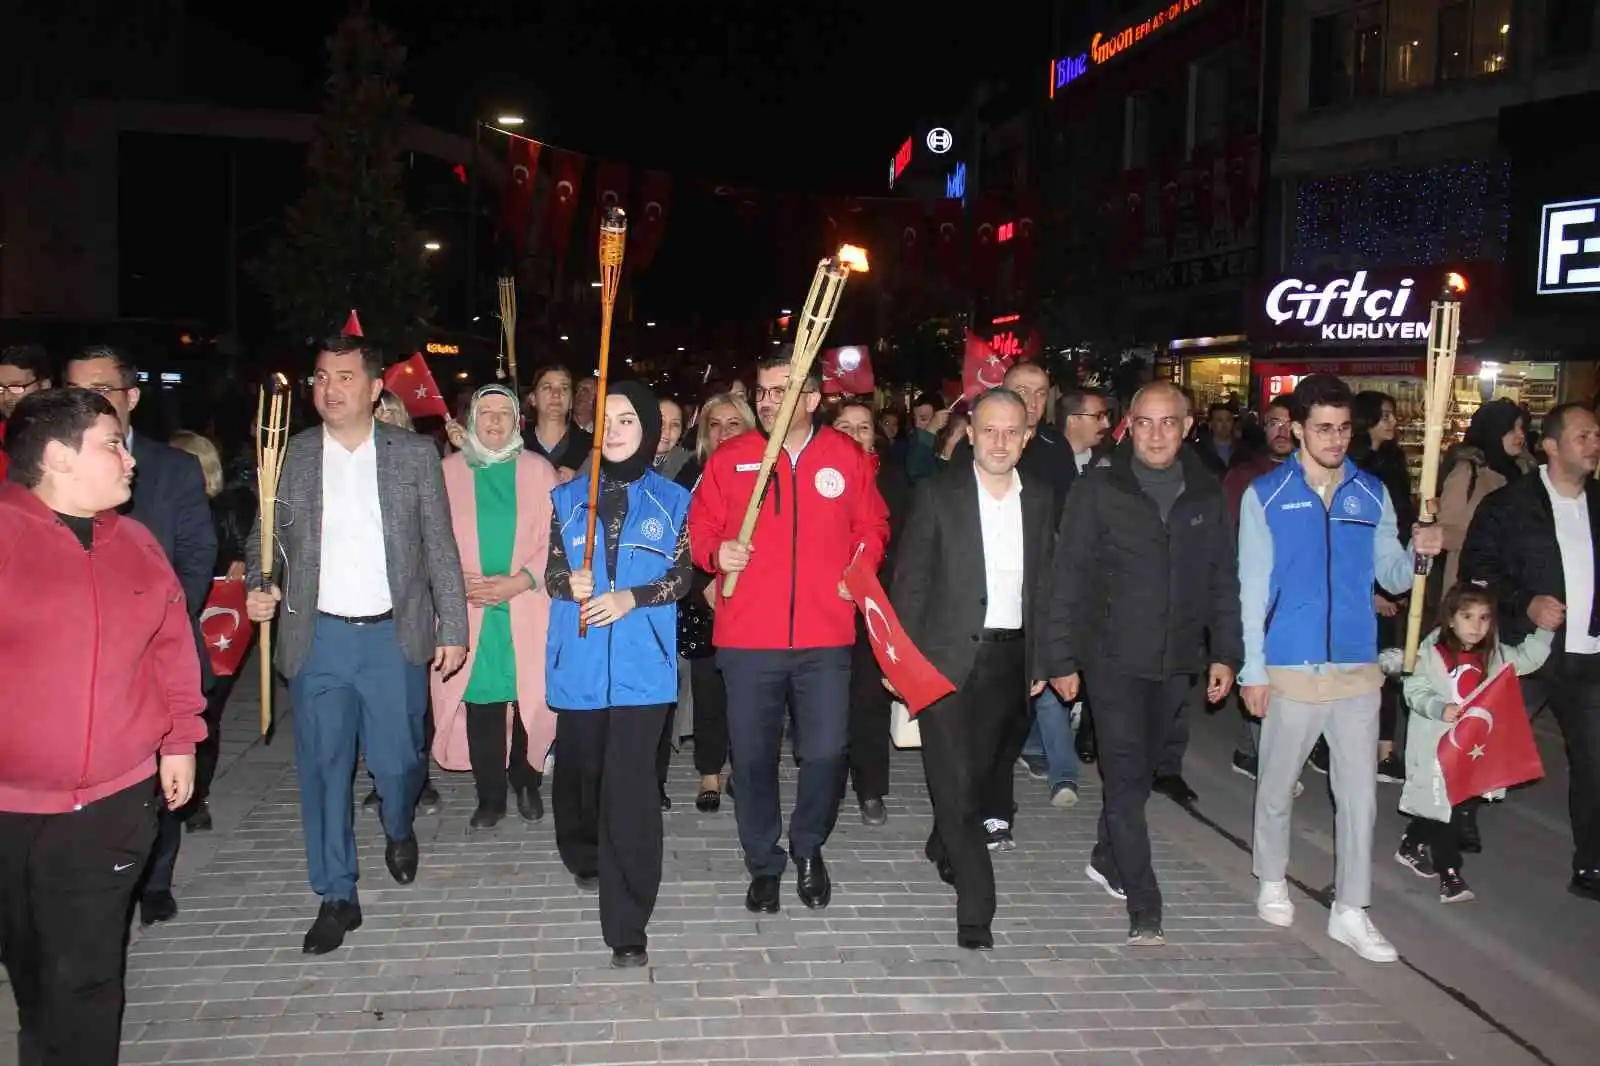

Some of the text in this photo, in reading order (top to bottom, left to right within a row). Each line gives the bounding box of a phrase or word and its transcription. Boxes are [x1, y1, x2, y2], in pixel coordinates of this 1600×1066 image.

[1056, 53, 1087, 88] Blue
[1098, 27, 1133, 63] moon
[1265, 271, 1415, 327] Çiftçi
[1321, 323, 1432, 339] KURUYEM
